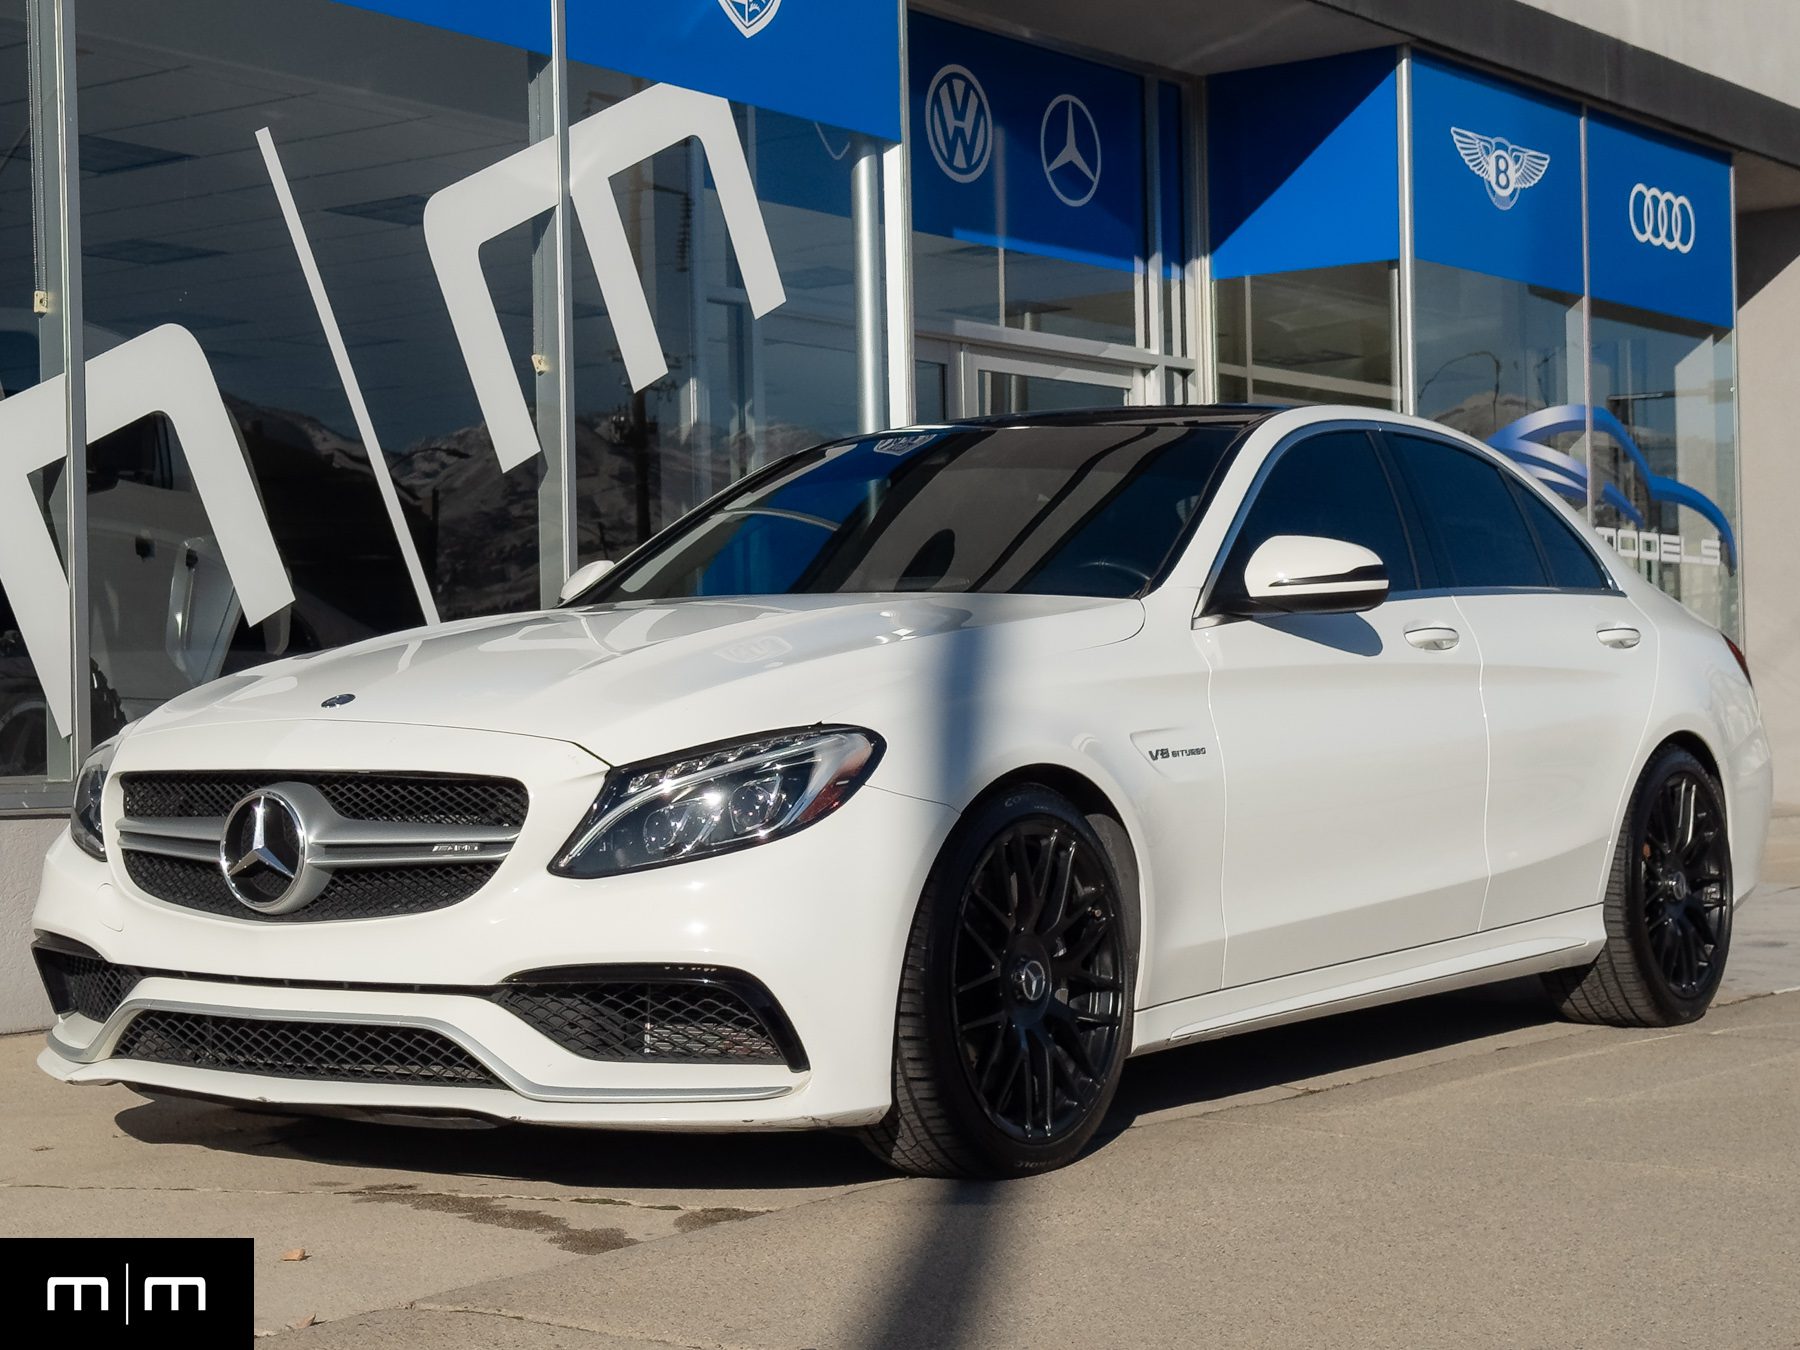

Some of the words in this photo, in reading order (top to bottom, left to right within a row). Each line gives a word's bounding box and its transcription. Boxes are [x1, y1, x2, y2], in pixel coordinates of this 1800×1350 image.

[1494, 154, 1509, 189] B
[1149, 748, 1170, 761] V8
[1171, 747, 1206, 758] BITURBO
